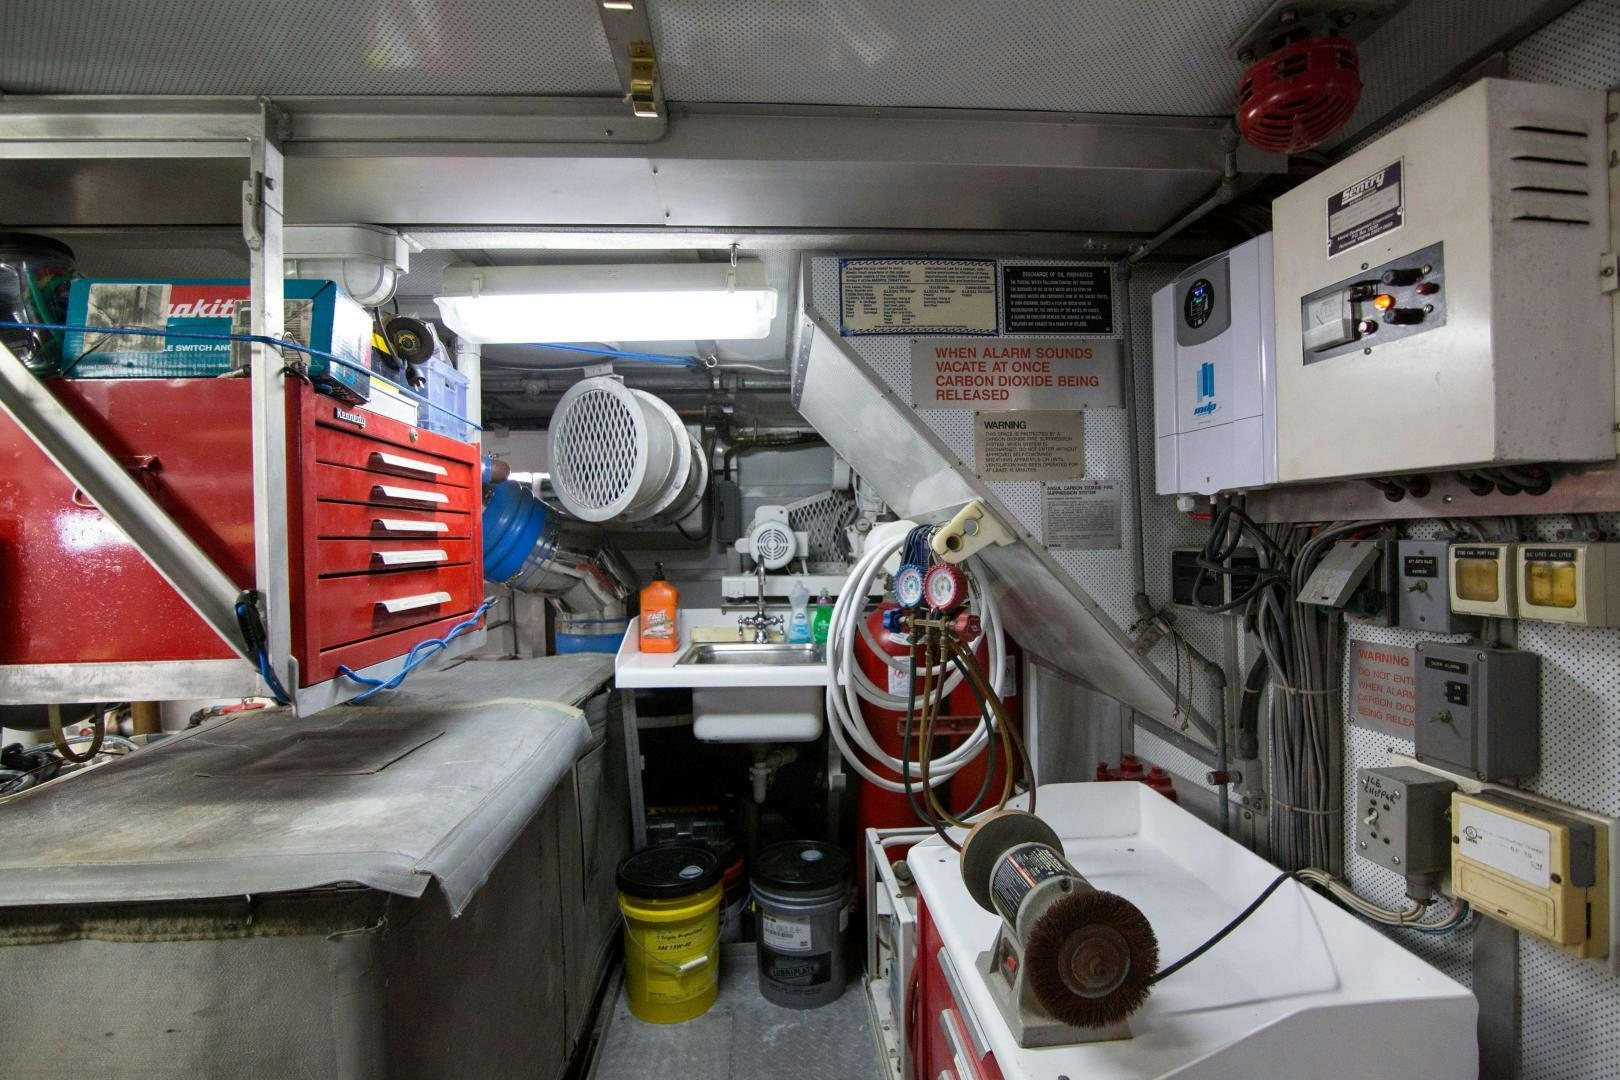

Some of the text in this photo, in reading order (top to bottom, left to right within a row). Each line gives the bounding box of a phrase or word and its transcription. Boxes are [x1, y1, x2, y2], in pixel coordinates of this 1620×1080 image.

[1342, 170, 1385, 200] Sentry
[175, 344, 213, 352] SWITCH
[935, 347, 1093, 360] WHEN ALARM SOUNDS
[936, 361, 1050, 373] VACATE AT ONCE
[935, 375, 1099, 387] CARBON DIOXIDE BEING
[936, 389, 1010, 401] RELEASED
[335, 407, 366, 428] Kennedy
[983, 420, 1027, 429] WARNING
[1359, 649, 1409, 667] WARNING
[1359, 667, 1370, 677] DO
[1373, 670, 1390, 681] NOT
[1358, 680, 1383, 693] WHEN
[1358, 694, 1393, 709] CARBON
[1358, 706, 1383, 720] BEING
